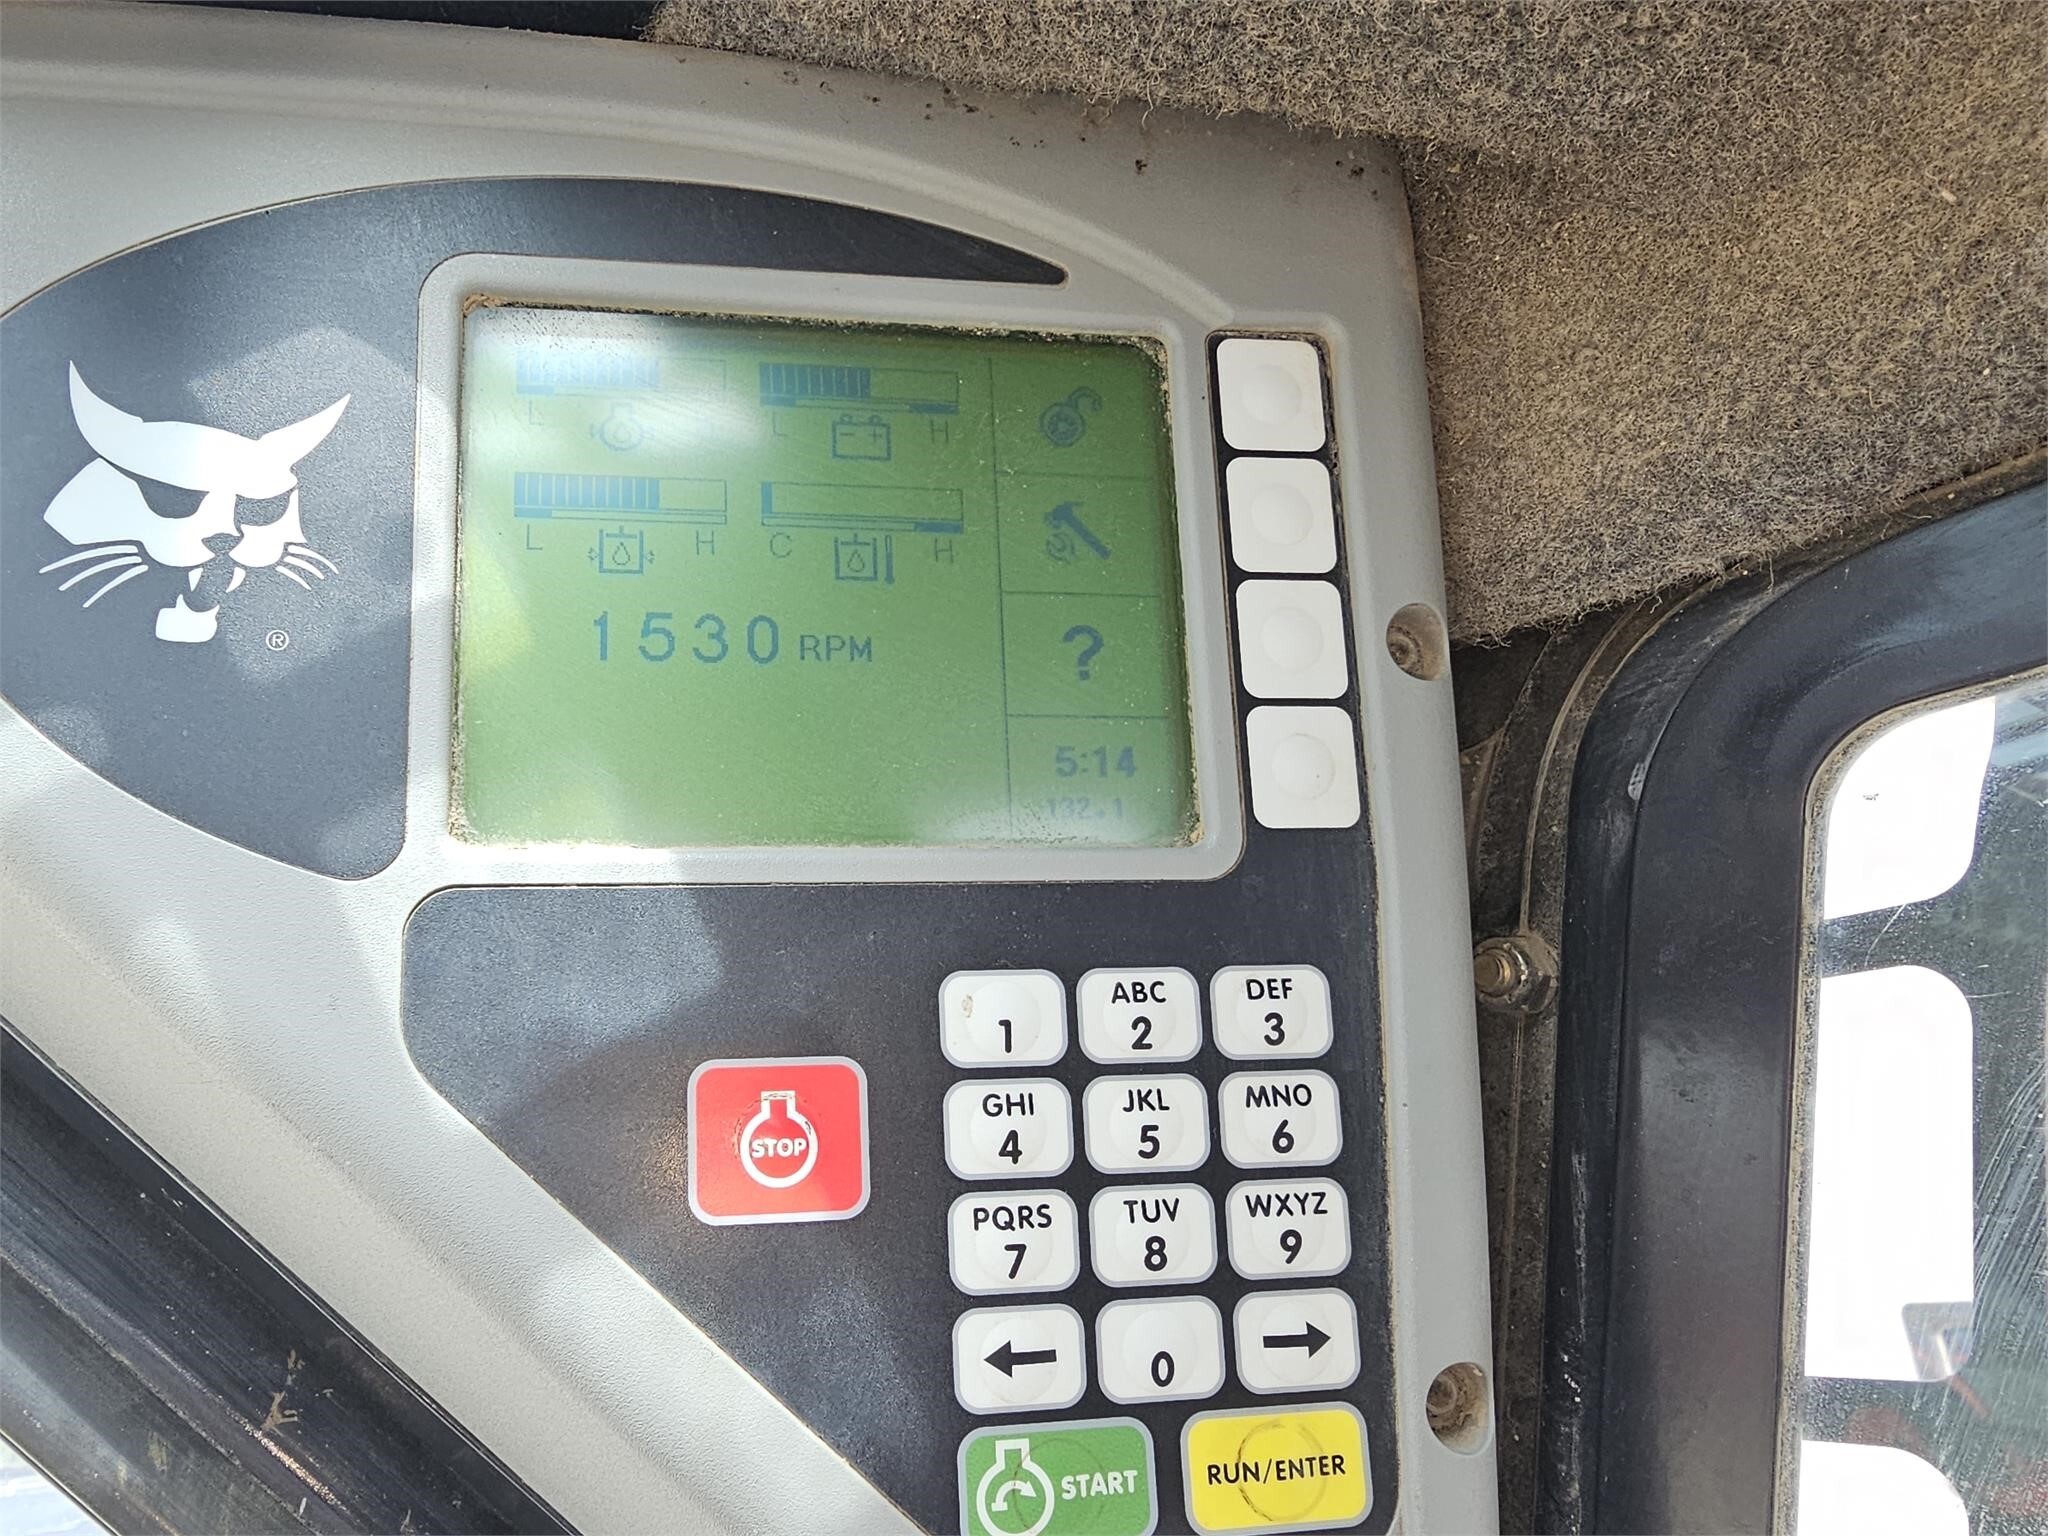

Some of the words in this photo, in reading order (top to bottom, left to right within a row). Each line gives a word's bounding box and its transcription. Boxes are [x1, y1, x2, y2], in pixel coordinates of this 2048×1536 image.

[930, 418, 949, 444] H
[526, 523, 544, 551] L
[695, 529, 715, 556] H
[769, 531, 793, 559] C
[933, 537, 954, 564] H
[593, 610, 780, 665] 1530
[800, 633, 874, 663] RPM
[1055, 745, 1138, 778] 5:14
[1111, 980, 1167, 1004] ABC
[1246, 978, 1294, 1001] DEF
[999, 1019, 1013, 1053] 1
[1131, 1016, 1153, 1050] 2
[1263, 1012, 1285, 1046] 3
[982, 1093, 1034, 1116] GHI
[1122, 1089, 1170, 1112] JKL
[1245, 1083, 1312, 1108] MNO
[751, 1137, 807, 1158] STOP
[999, 1130, 1022, 1164] 4
[1138, 1124, 1160, 1159] 5
[1272, 1119, 1294, 1153] 6
[973, 1204, 1053, 1232] PQRS
[1123, 1197, 1180, 1224] TUV
[1245, 1192, 1328, 1217] WXYZ
[1144, 1235, 1168, 1272] 8
[1279, 1229, 1303, 1264] 9
[1004, 1244, 1027, 1279] 7
[1151, 1351, 1175, 1387] 0
[1207, 1454, 1346, 1486] RUN/ENTER
[1061, 1470, 1138, 1500] START
